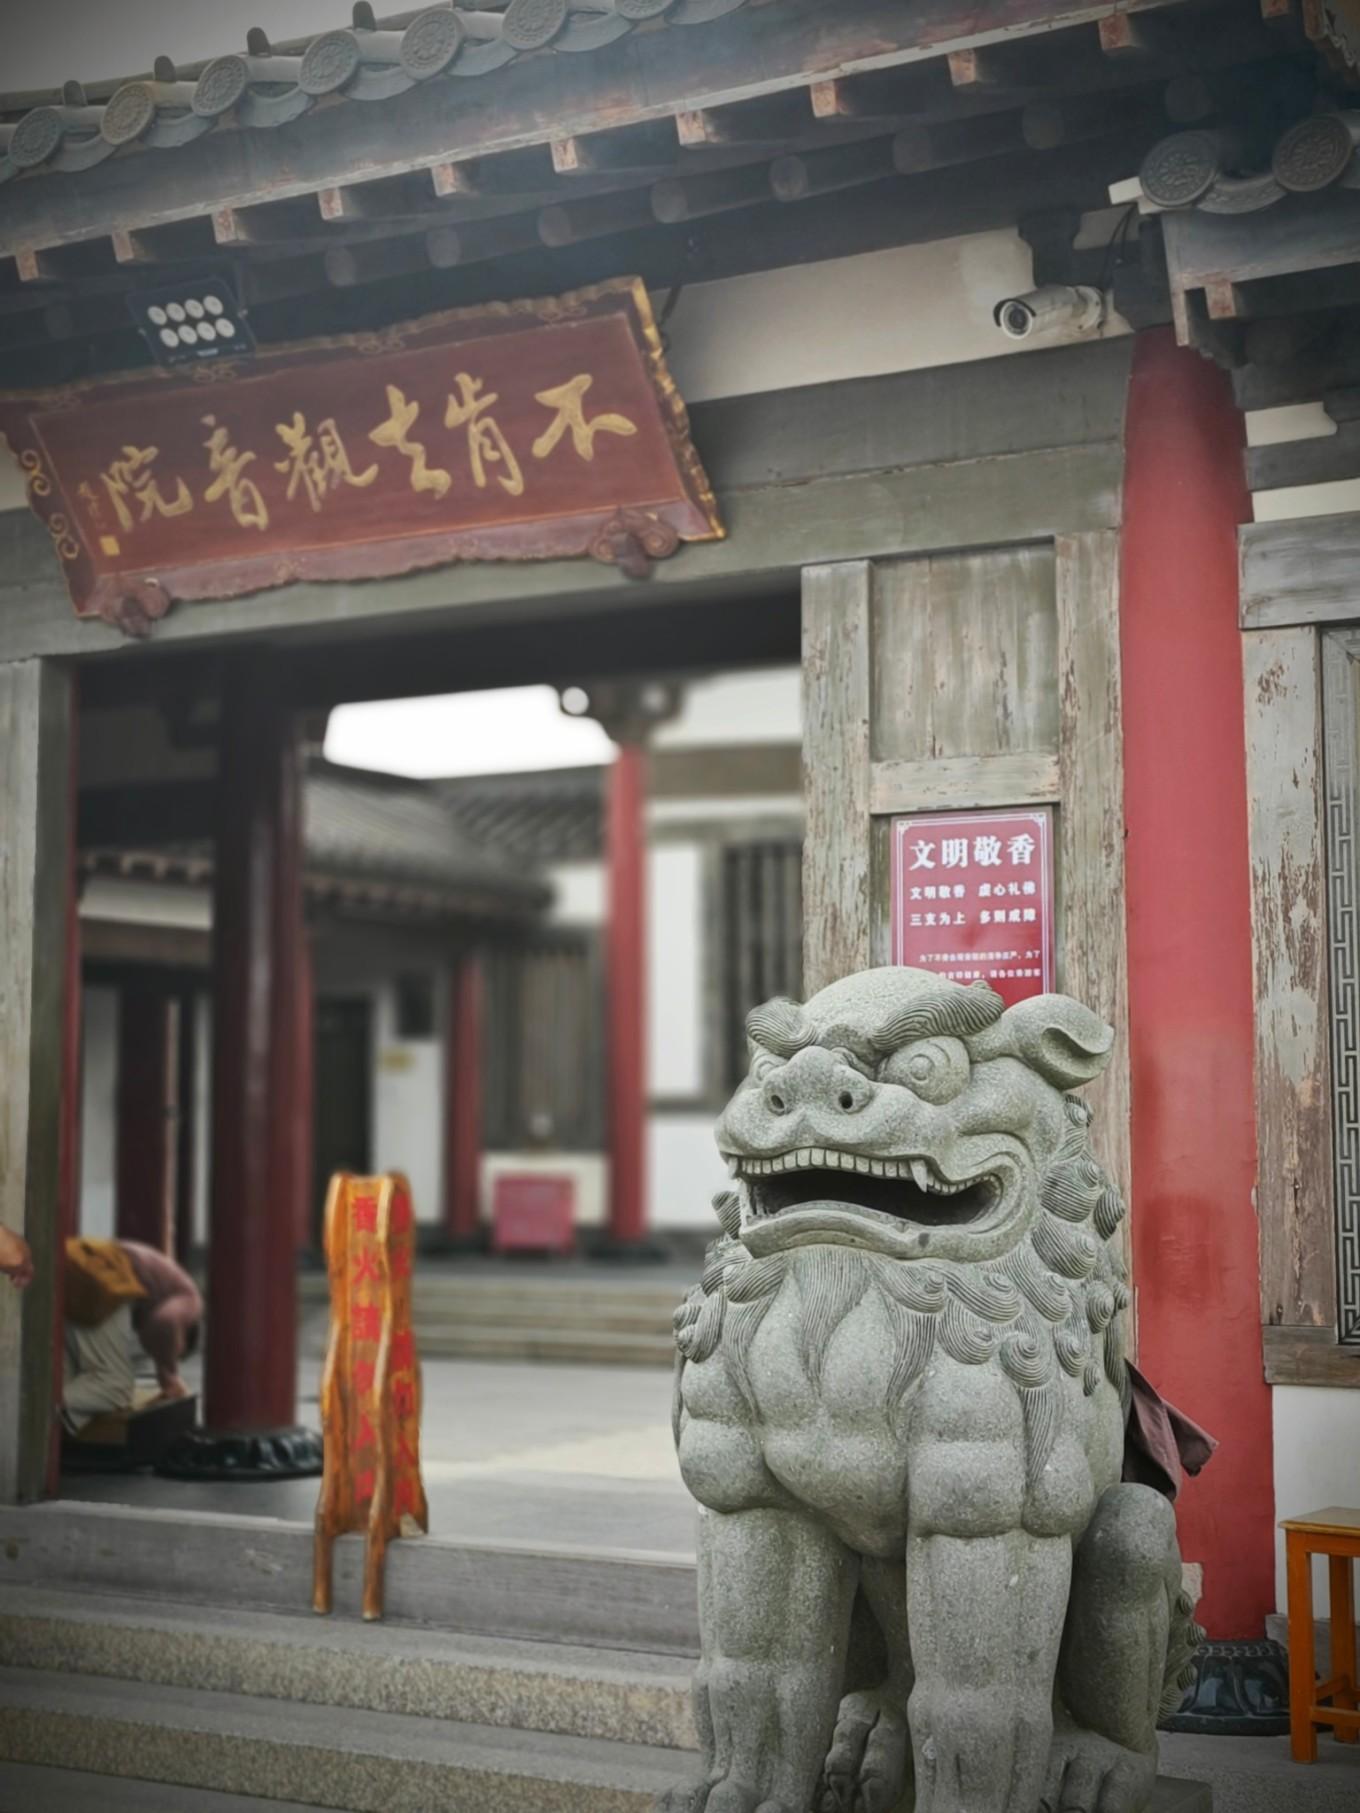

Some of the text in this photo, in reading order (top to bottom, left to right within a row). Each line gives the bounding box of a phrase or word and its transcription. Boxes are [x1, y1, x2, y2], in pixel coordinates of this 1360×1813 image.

[909, 833, 1035, 871] 文明敬香
[910, 884, 966, 900] 文明敬香
